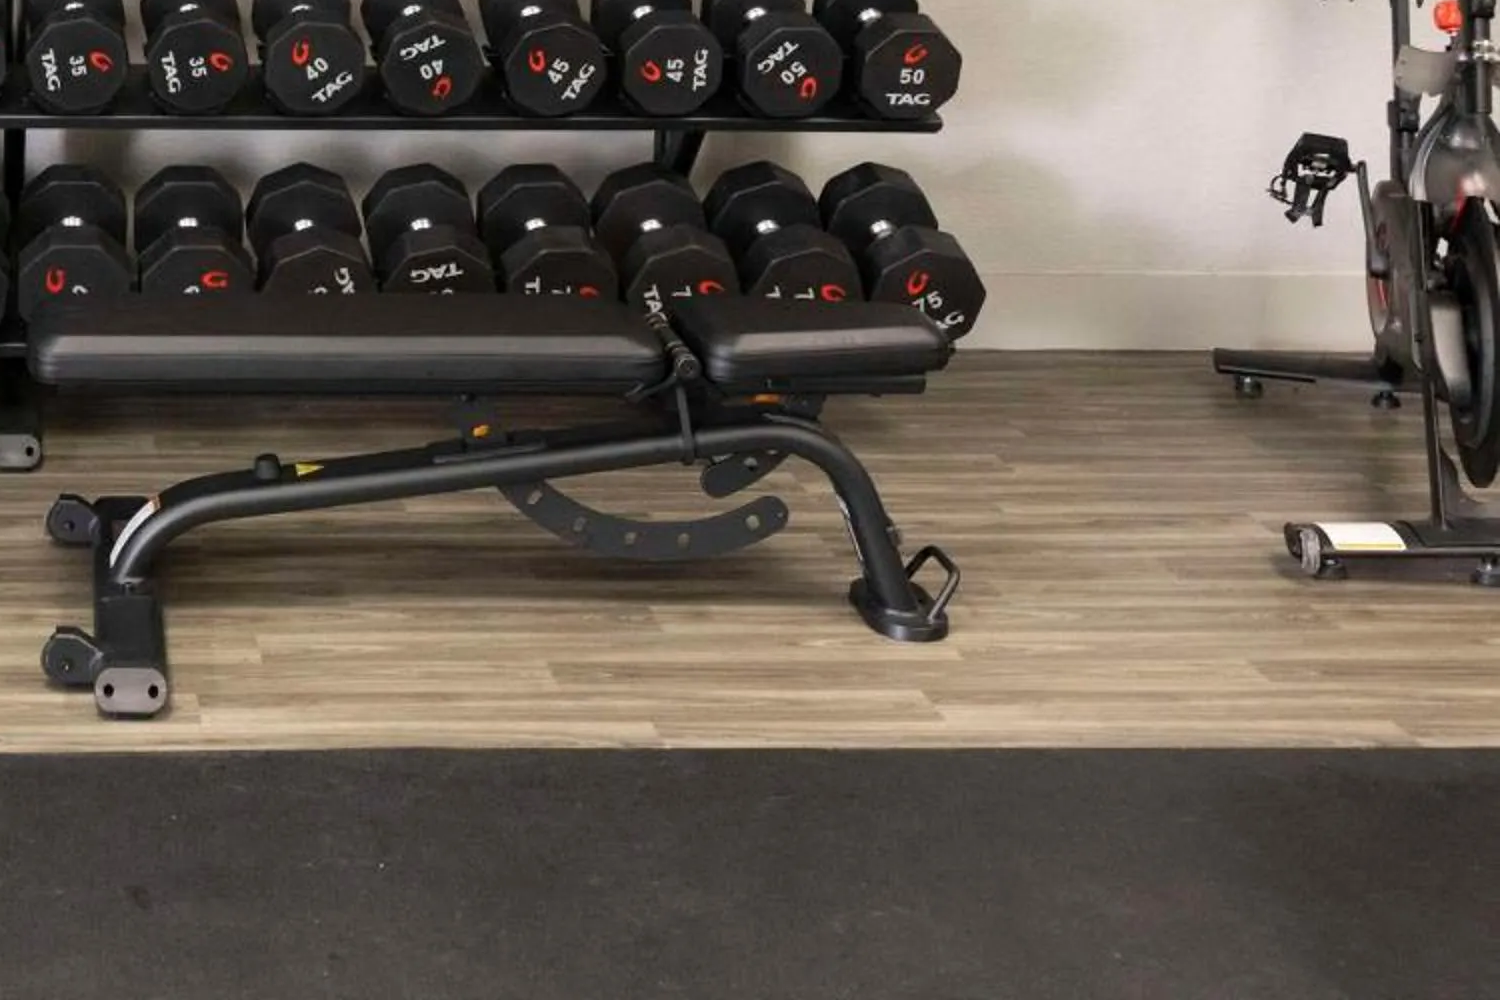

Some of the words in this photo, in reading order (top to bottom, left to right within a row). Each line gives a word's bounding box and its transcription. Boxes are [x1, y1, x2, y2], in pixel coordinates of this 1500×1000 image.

[399, 34, 446, 61] TAG
[757, 41, 799, 73] TAG
[41, 48, 61, 92] TAG
[69, 55, 88, 77] 35
[161, 50, 182, 93] TAG
[188, 56, 208, 78] 35
[306, 57, 329, 81] 40
[419, 59, 443, 80] 40
[547, 58, 570, 84] 45
[666, 58, 685, 83] 45
[692, 48, 709, 92] TAG
[781, 61, 807, 85] 50
[899, 68, 925, 85] 50
[311, 71, 353, 103] TAG
[561, 62, 596, 100] TAG
[885, 93, 931, 106] TAG
[410, 262, 464, 283] TAG
[671, 285, 693, 297] 7
[794, 287, 815, 300] 7
[911, 290, 943, 314] 75
